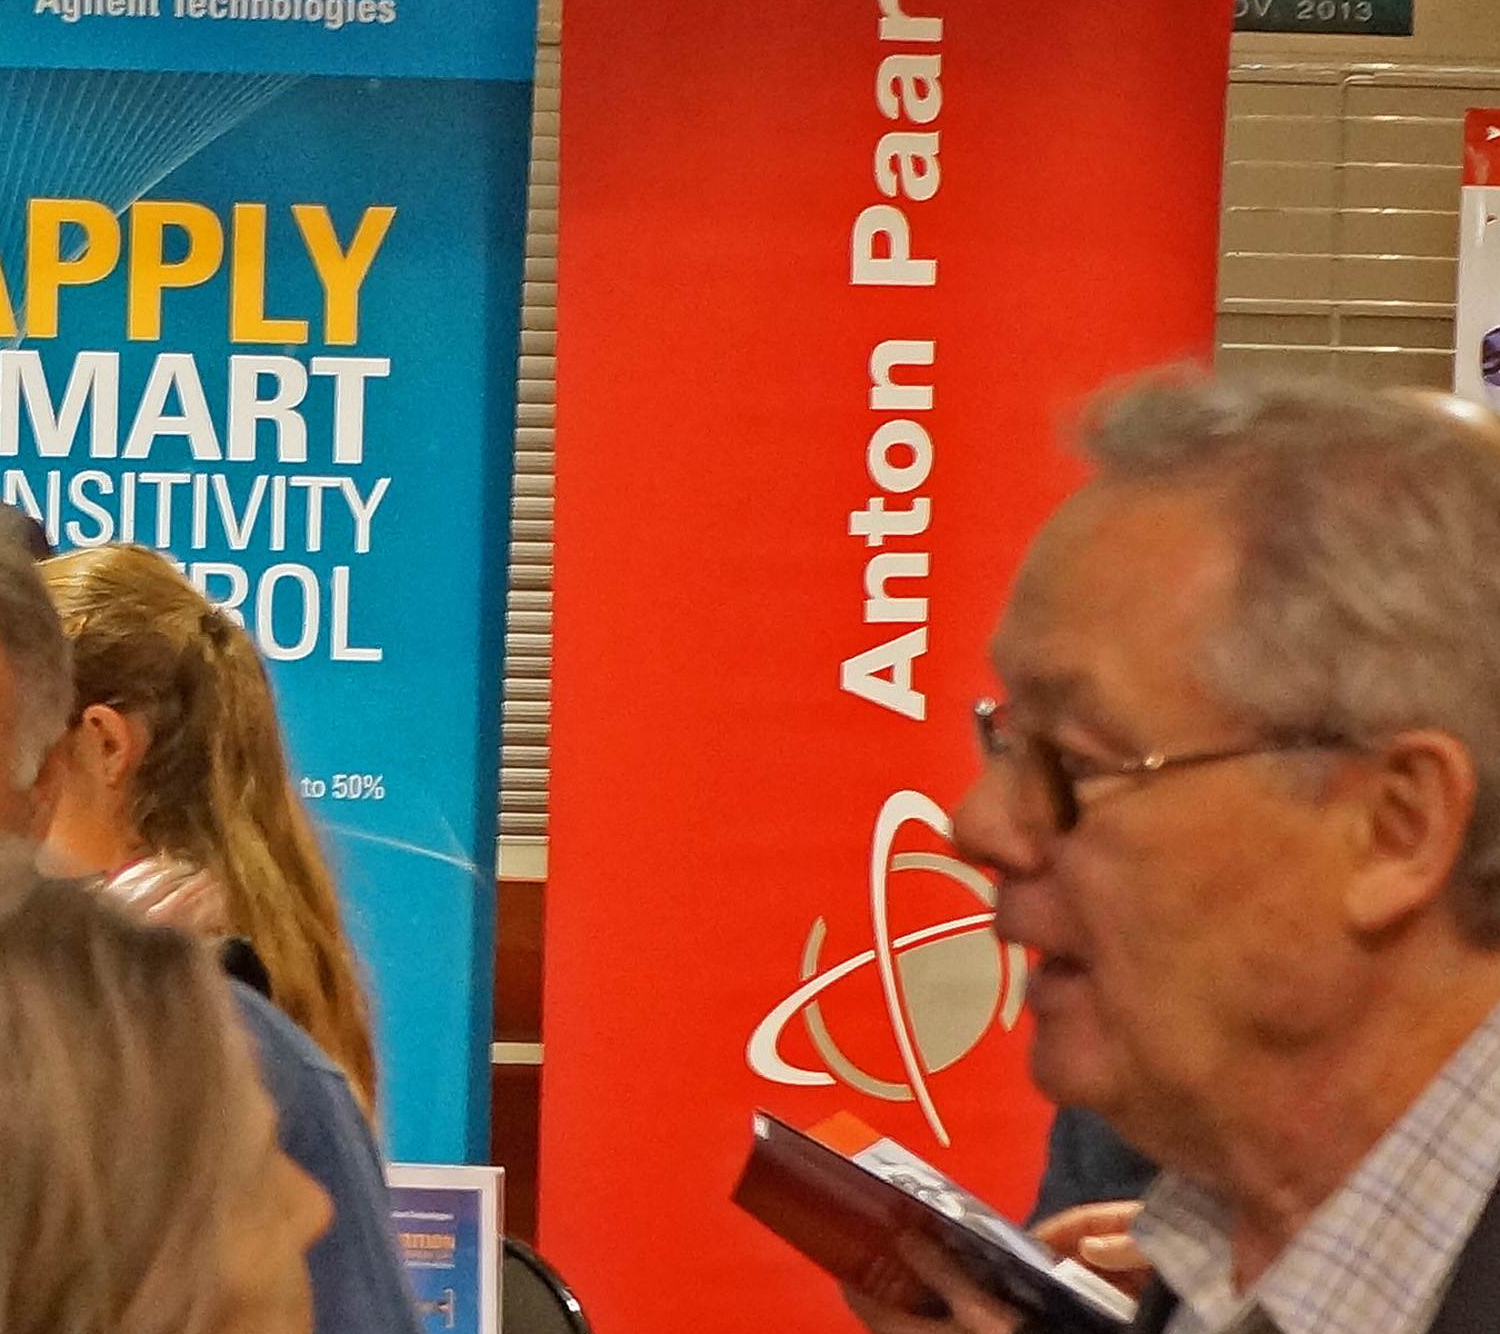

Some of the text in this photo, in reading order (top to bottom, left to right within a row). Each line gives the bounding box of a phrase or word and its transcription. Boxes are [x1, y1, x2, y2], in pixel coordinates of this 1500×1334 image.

[1296, 0, 1373, 21] 2013
[839, 339, 935, 722] Anton
[301, 774, 386, 800] to 50%
